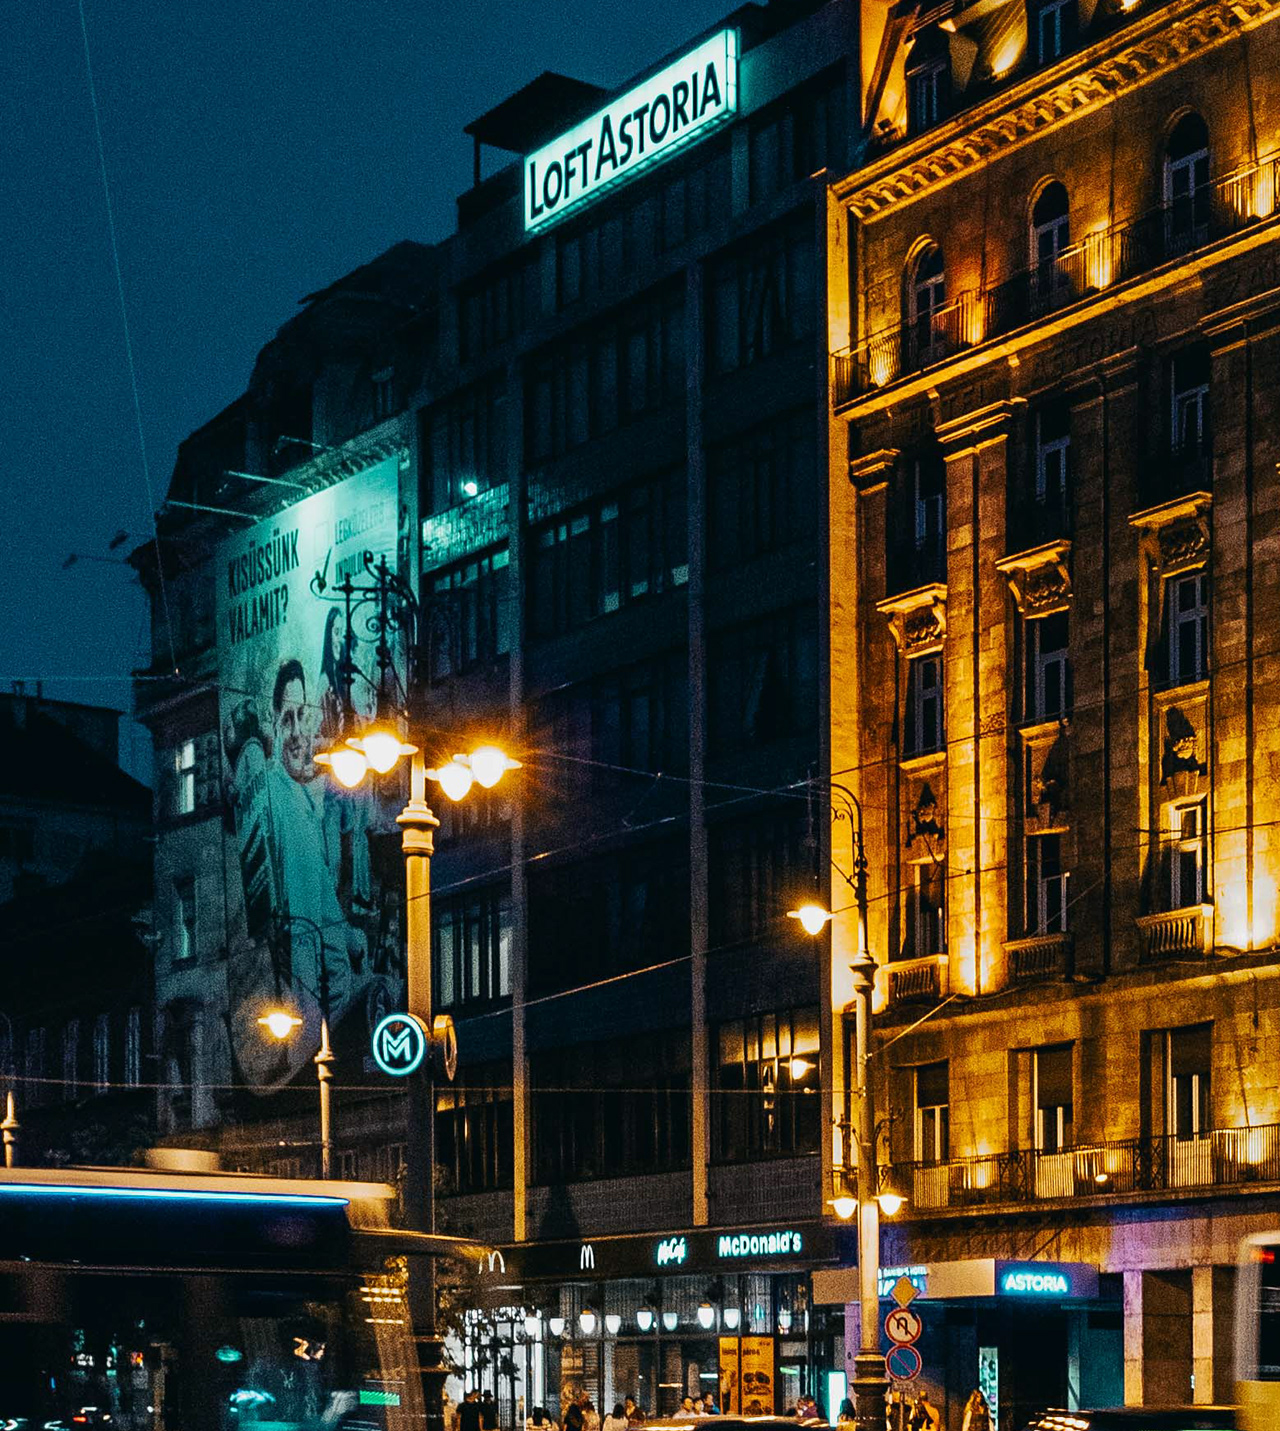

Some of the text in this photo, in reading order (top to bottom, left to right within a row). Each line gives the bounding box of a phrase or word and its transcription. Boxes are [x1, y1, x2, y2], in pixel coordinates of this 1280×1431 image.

[228, 527, 299, 597] KISÜSSÜNK
[229, 583, 288, 645] VALAMIT?
[718, 1230, 802, 1257] McDonald's
[1005, 1273, 1068, 1293] ASTORIA
